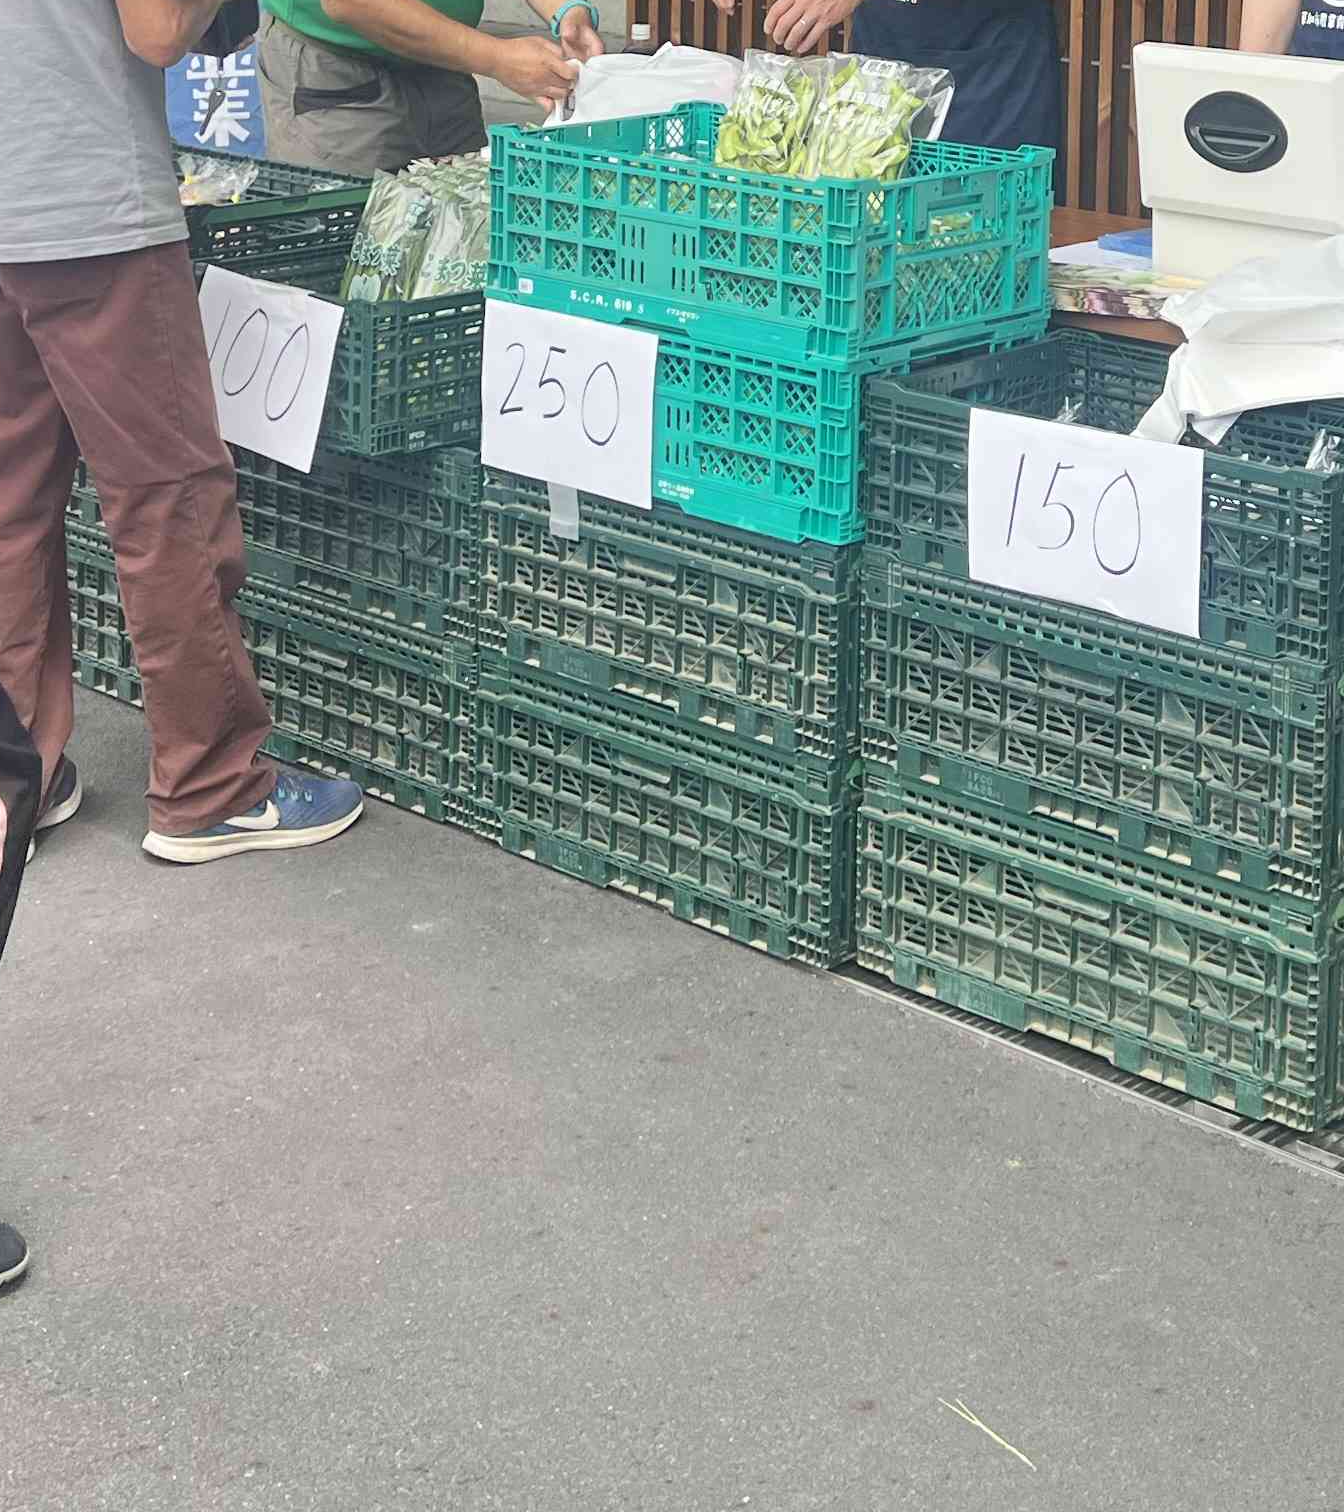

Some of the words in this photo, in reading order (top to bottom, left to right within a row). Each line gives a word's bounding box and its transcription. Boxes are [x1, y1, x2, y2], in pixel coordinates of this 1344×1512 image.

[208, 298, 311, 422] 100
[498, 341, 622, 448] 250
[1004, 451, 1143, 577] 150
